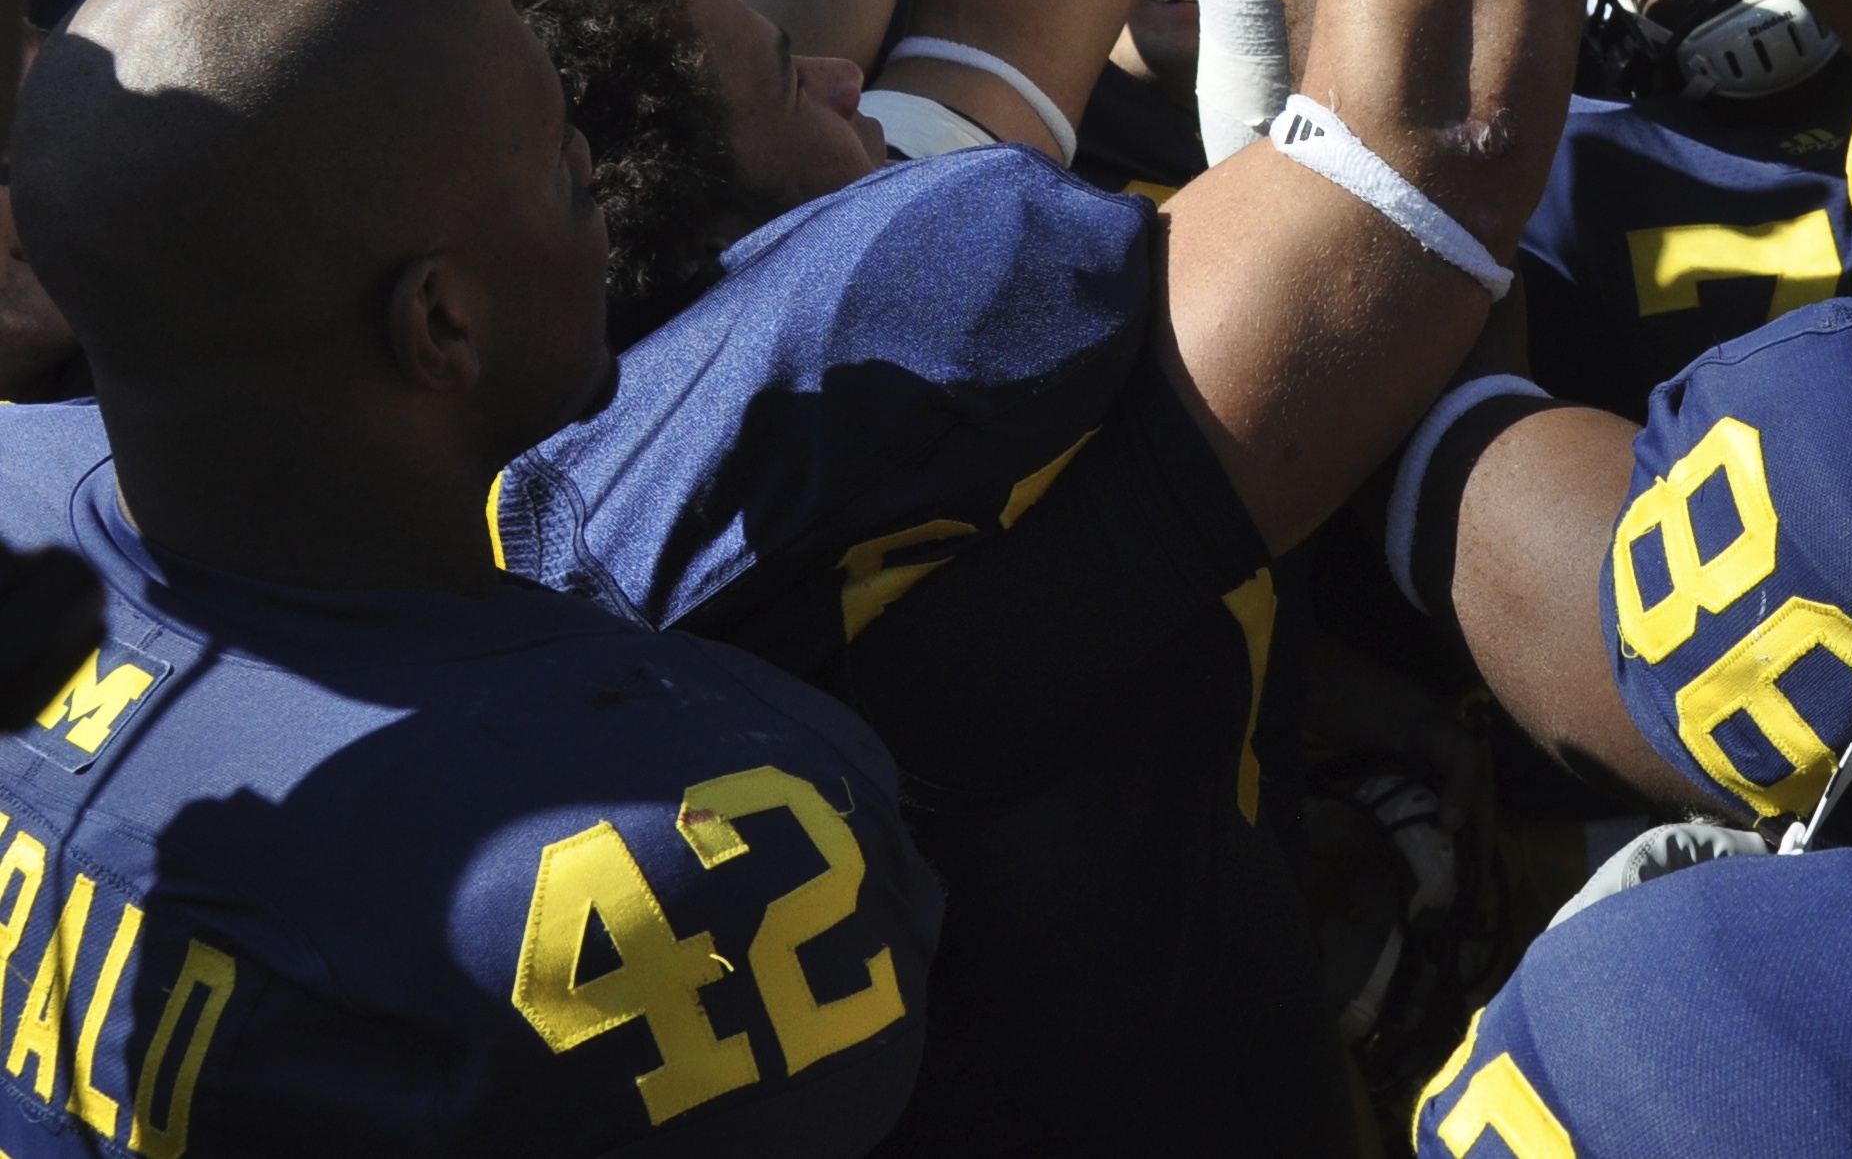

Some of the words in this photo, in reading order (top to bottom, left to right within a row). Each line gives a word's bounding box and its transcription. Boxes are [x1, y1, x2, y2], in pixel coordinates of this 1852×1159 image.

[1748, 10, 1796, 38] Riddell
[35, 648, 158, 754] M
[512, 766, 906, 1126] 42
